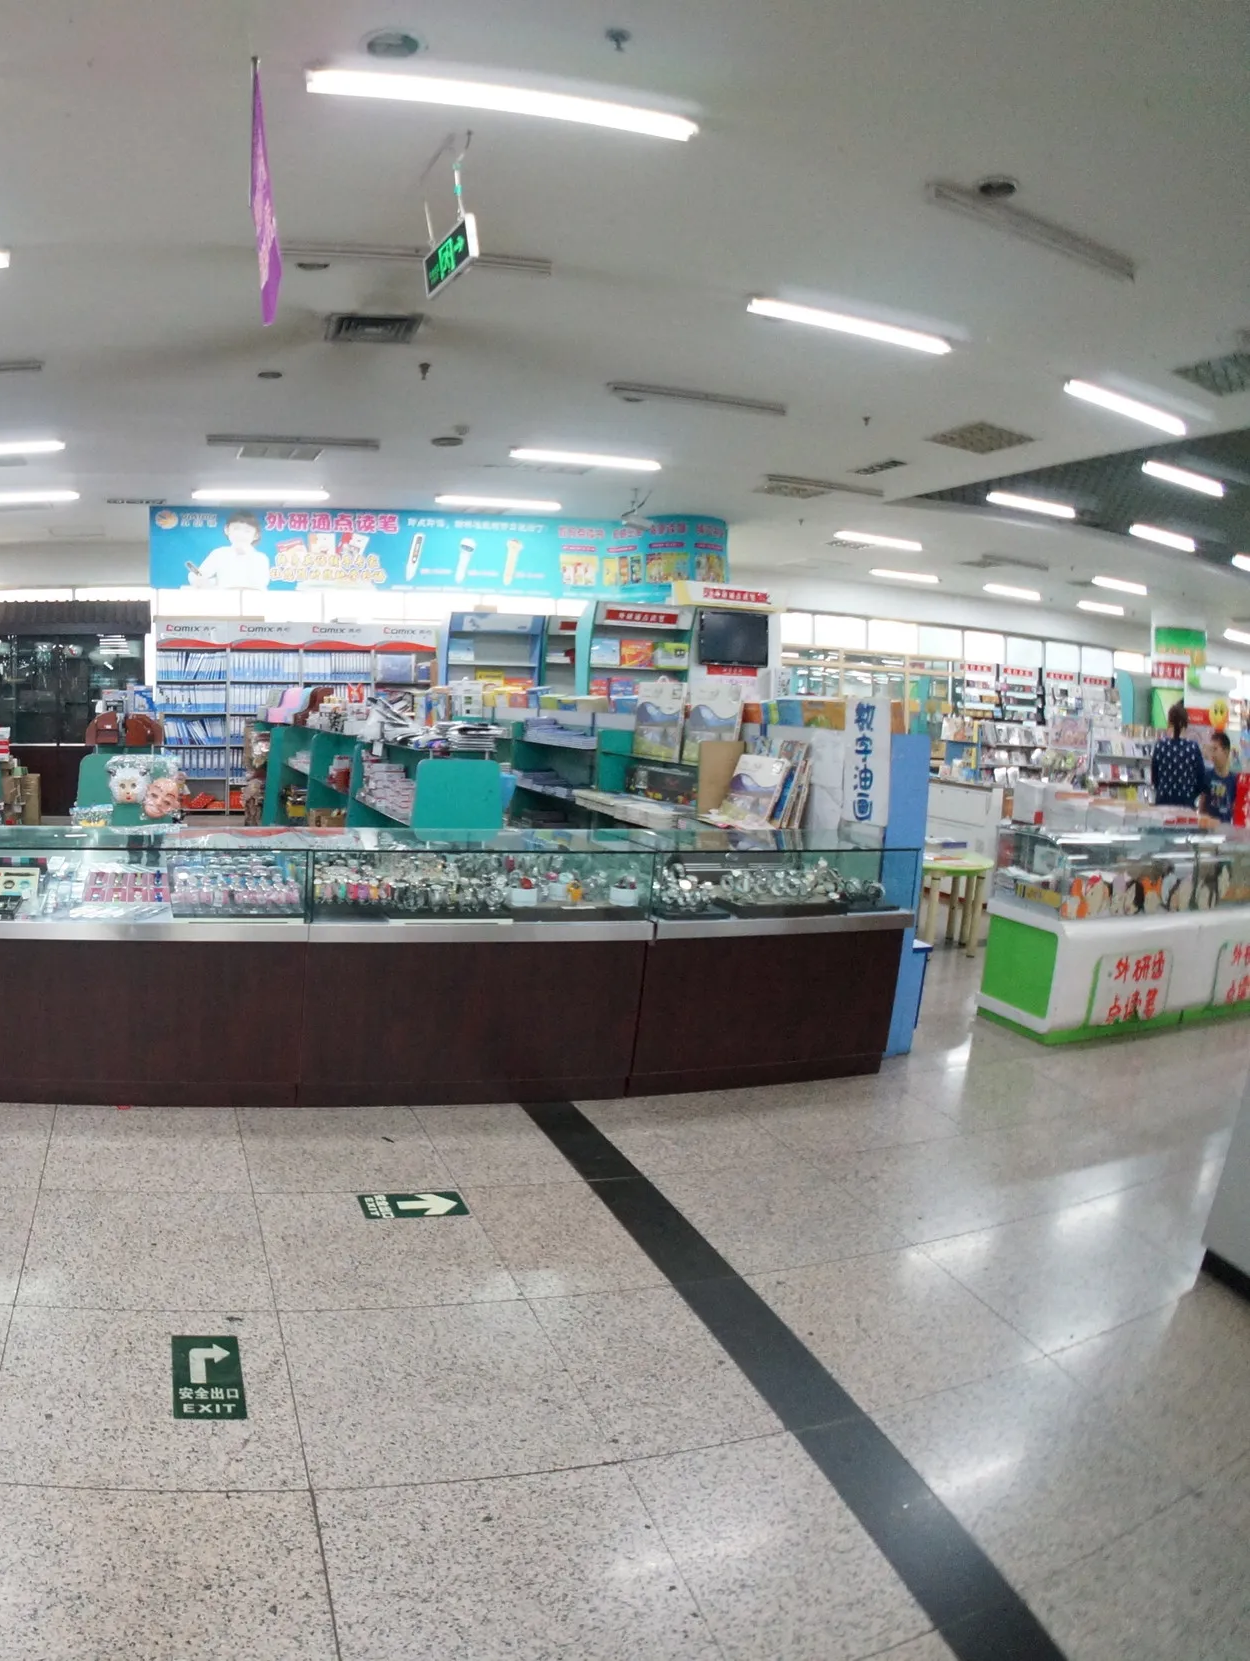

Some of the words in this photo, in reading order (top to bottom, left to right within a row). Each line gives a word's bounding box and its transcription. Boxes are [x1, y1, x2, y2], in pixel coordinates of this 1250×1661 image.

[265, 511, 399, 533] 外研通点读笔
[853, 702, 876, 821] 数字油画
[1114, 949, 1165, 983] 外研通
[1105, 987, 1159, 1025] 点读笔
[364, 1197, 381, 1217] EXIT
[178, 1386, 240, 1400] 安全出口
[183, 1403, 236, 1413] EXIT
